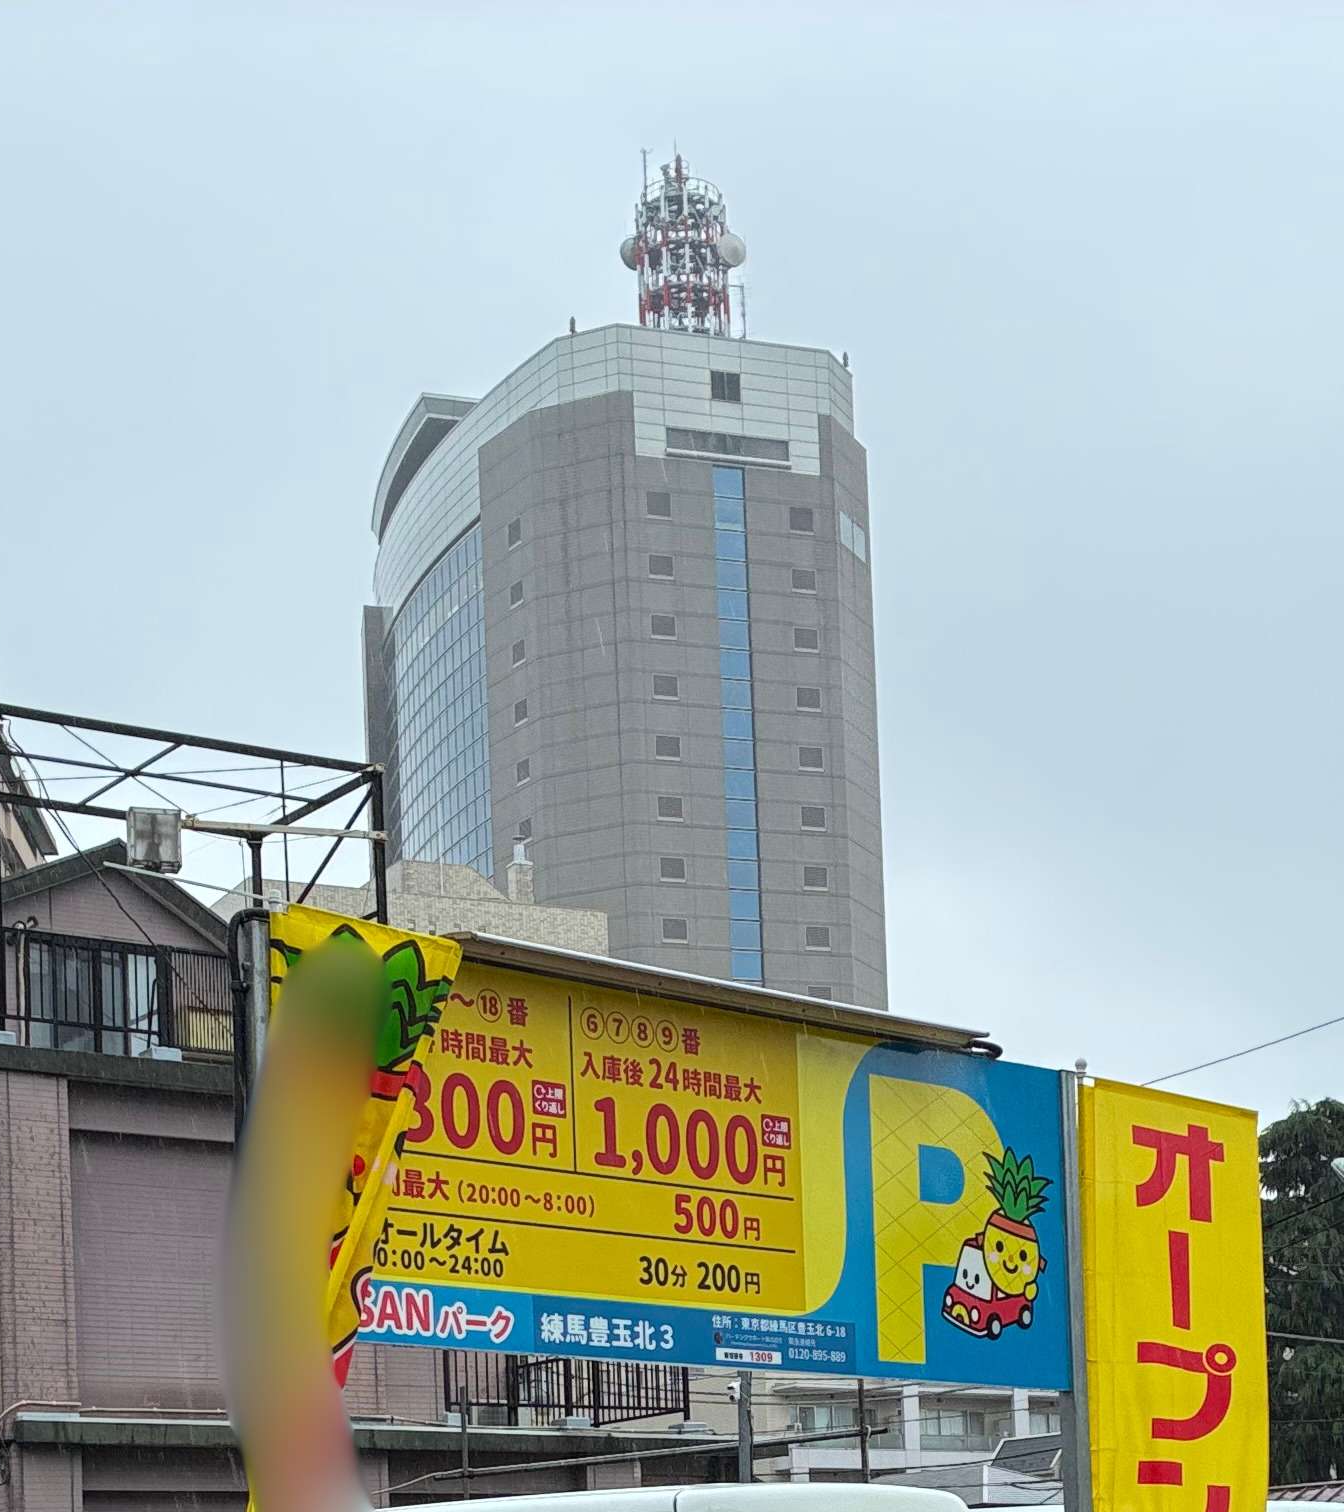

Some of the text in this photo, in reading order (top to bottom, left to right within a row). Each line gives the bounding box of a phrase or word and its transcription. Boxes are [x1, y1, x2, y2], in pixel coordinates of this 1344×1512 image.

[429, 1028, 533, 1069] 時間最大
[580, 1051, 762, 1104] 入庫後24時間最大
[593, 1096, 786, 1187] 1,000円
[392, 1168, 449, 1200] 最大
[674, 1194, 761, 1241] 500円
[870, 1075, 1006, 1364] P
[639, 1256, 761, 1294] 30分 200円
[749, 1352, 773, 1363] 1309
